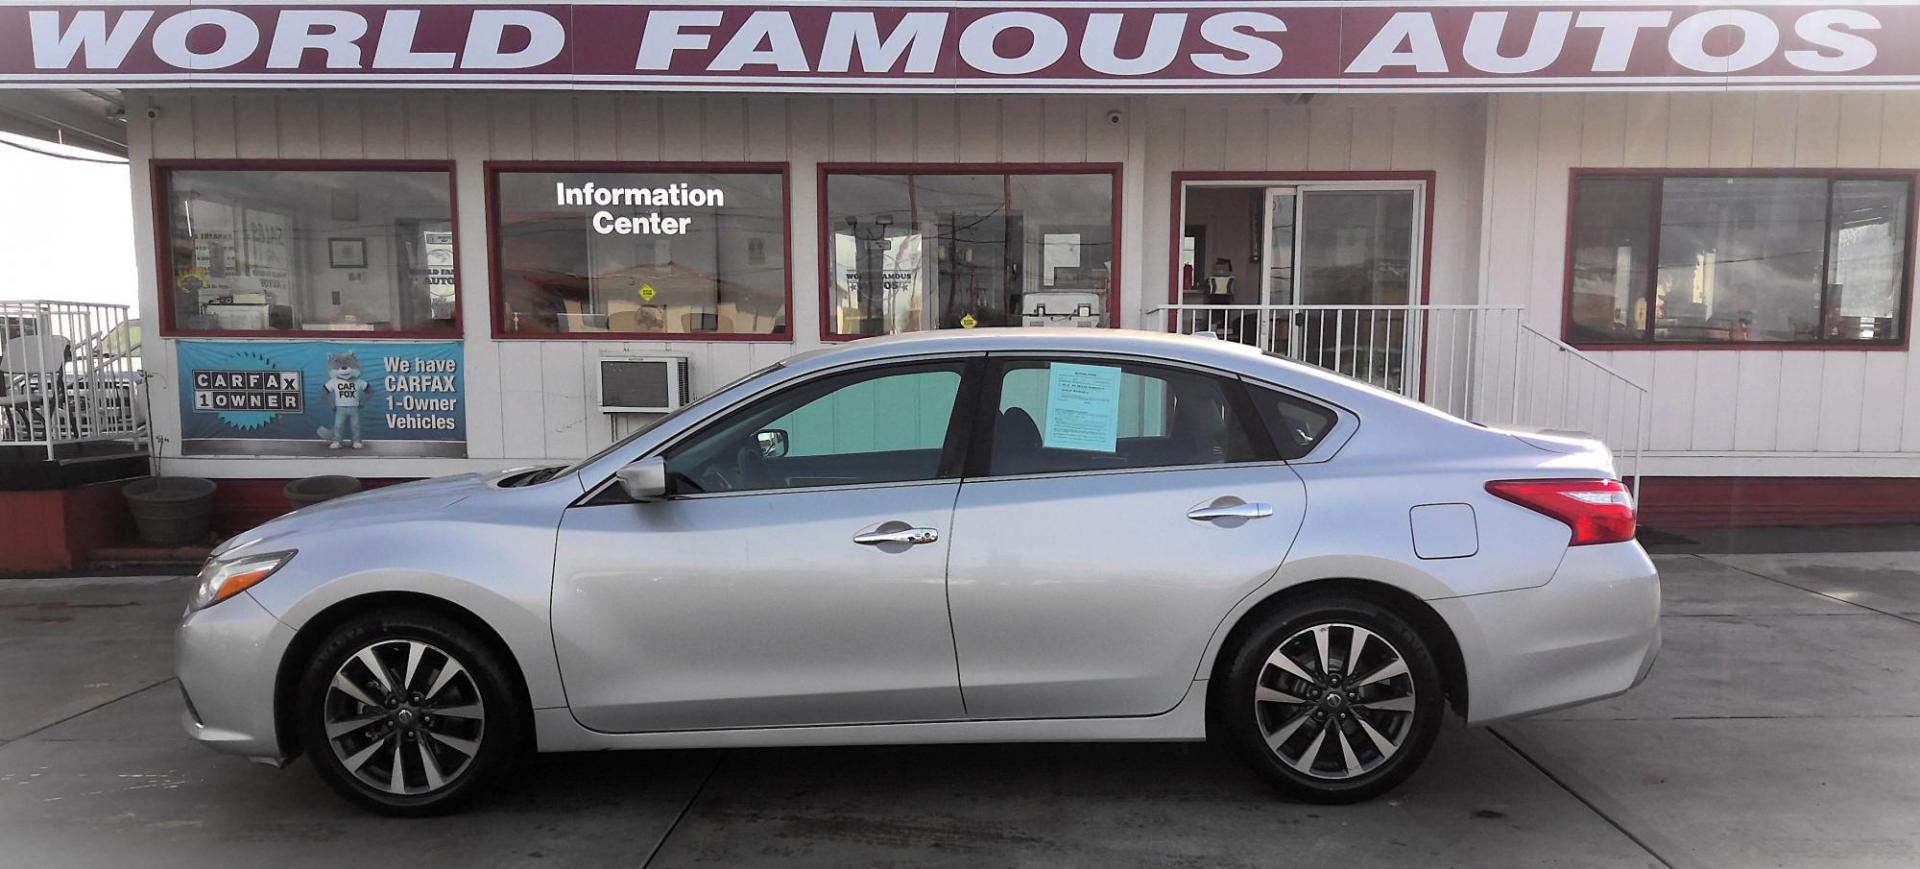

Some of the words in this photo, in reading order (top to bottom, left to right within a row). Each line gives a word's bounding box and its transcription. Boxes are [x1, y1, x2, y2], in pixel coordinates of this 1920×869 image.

[28, 10, 566, 70] WORLD
[635, 10, 1284, 75] FAMOUS
[1343, 9, 1881, 75] AUTOS
[556, 182, 724, 206] Information
[592, 210, 692, 235] Center
[384, 356, 410, 373] We
[415, 357, 456, 373] have
[197, 374, 298, 391] CARFAX
[337, 382, 356, 392] CAR
[384, 376, 456, 393] CARFAX
[339, 390, 356, 400] FOX
[386, 396, 457, 412] 1-Owner
[386, 413, 456, 430] Vehicles
